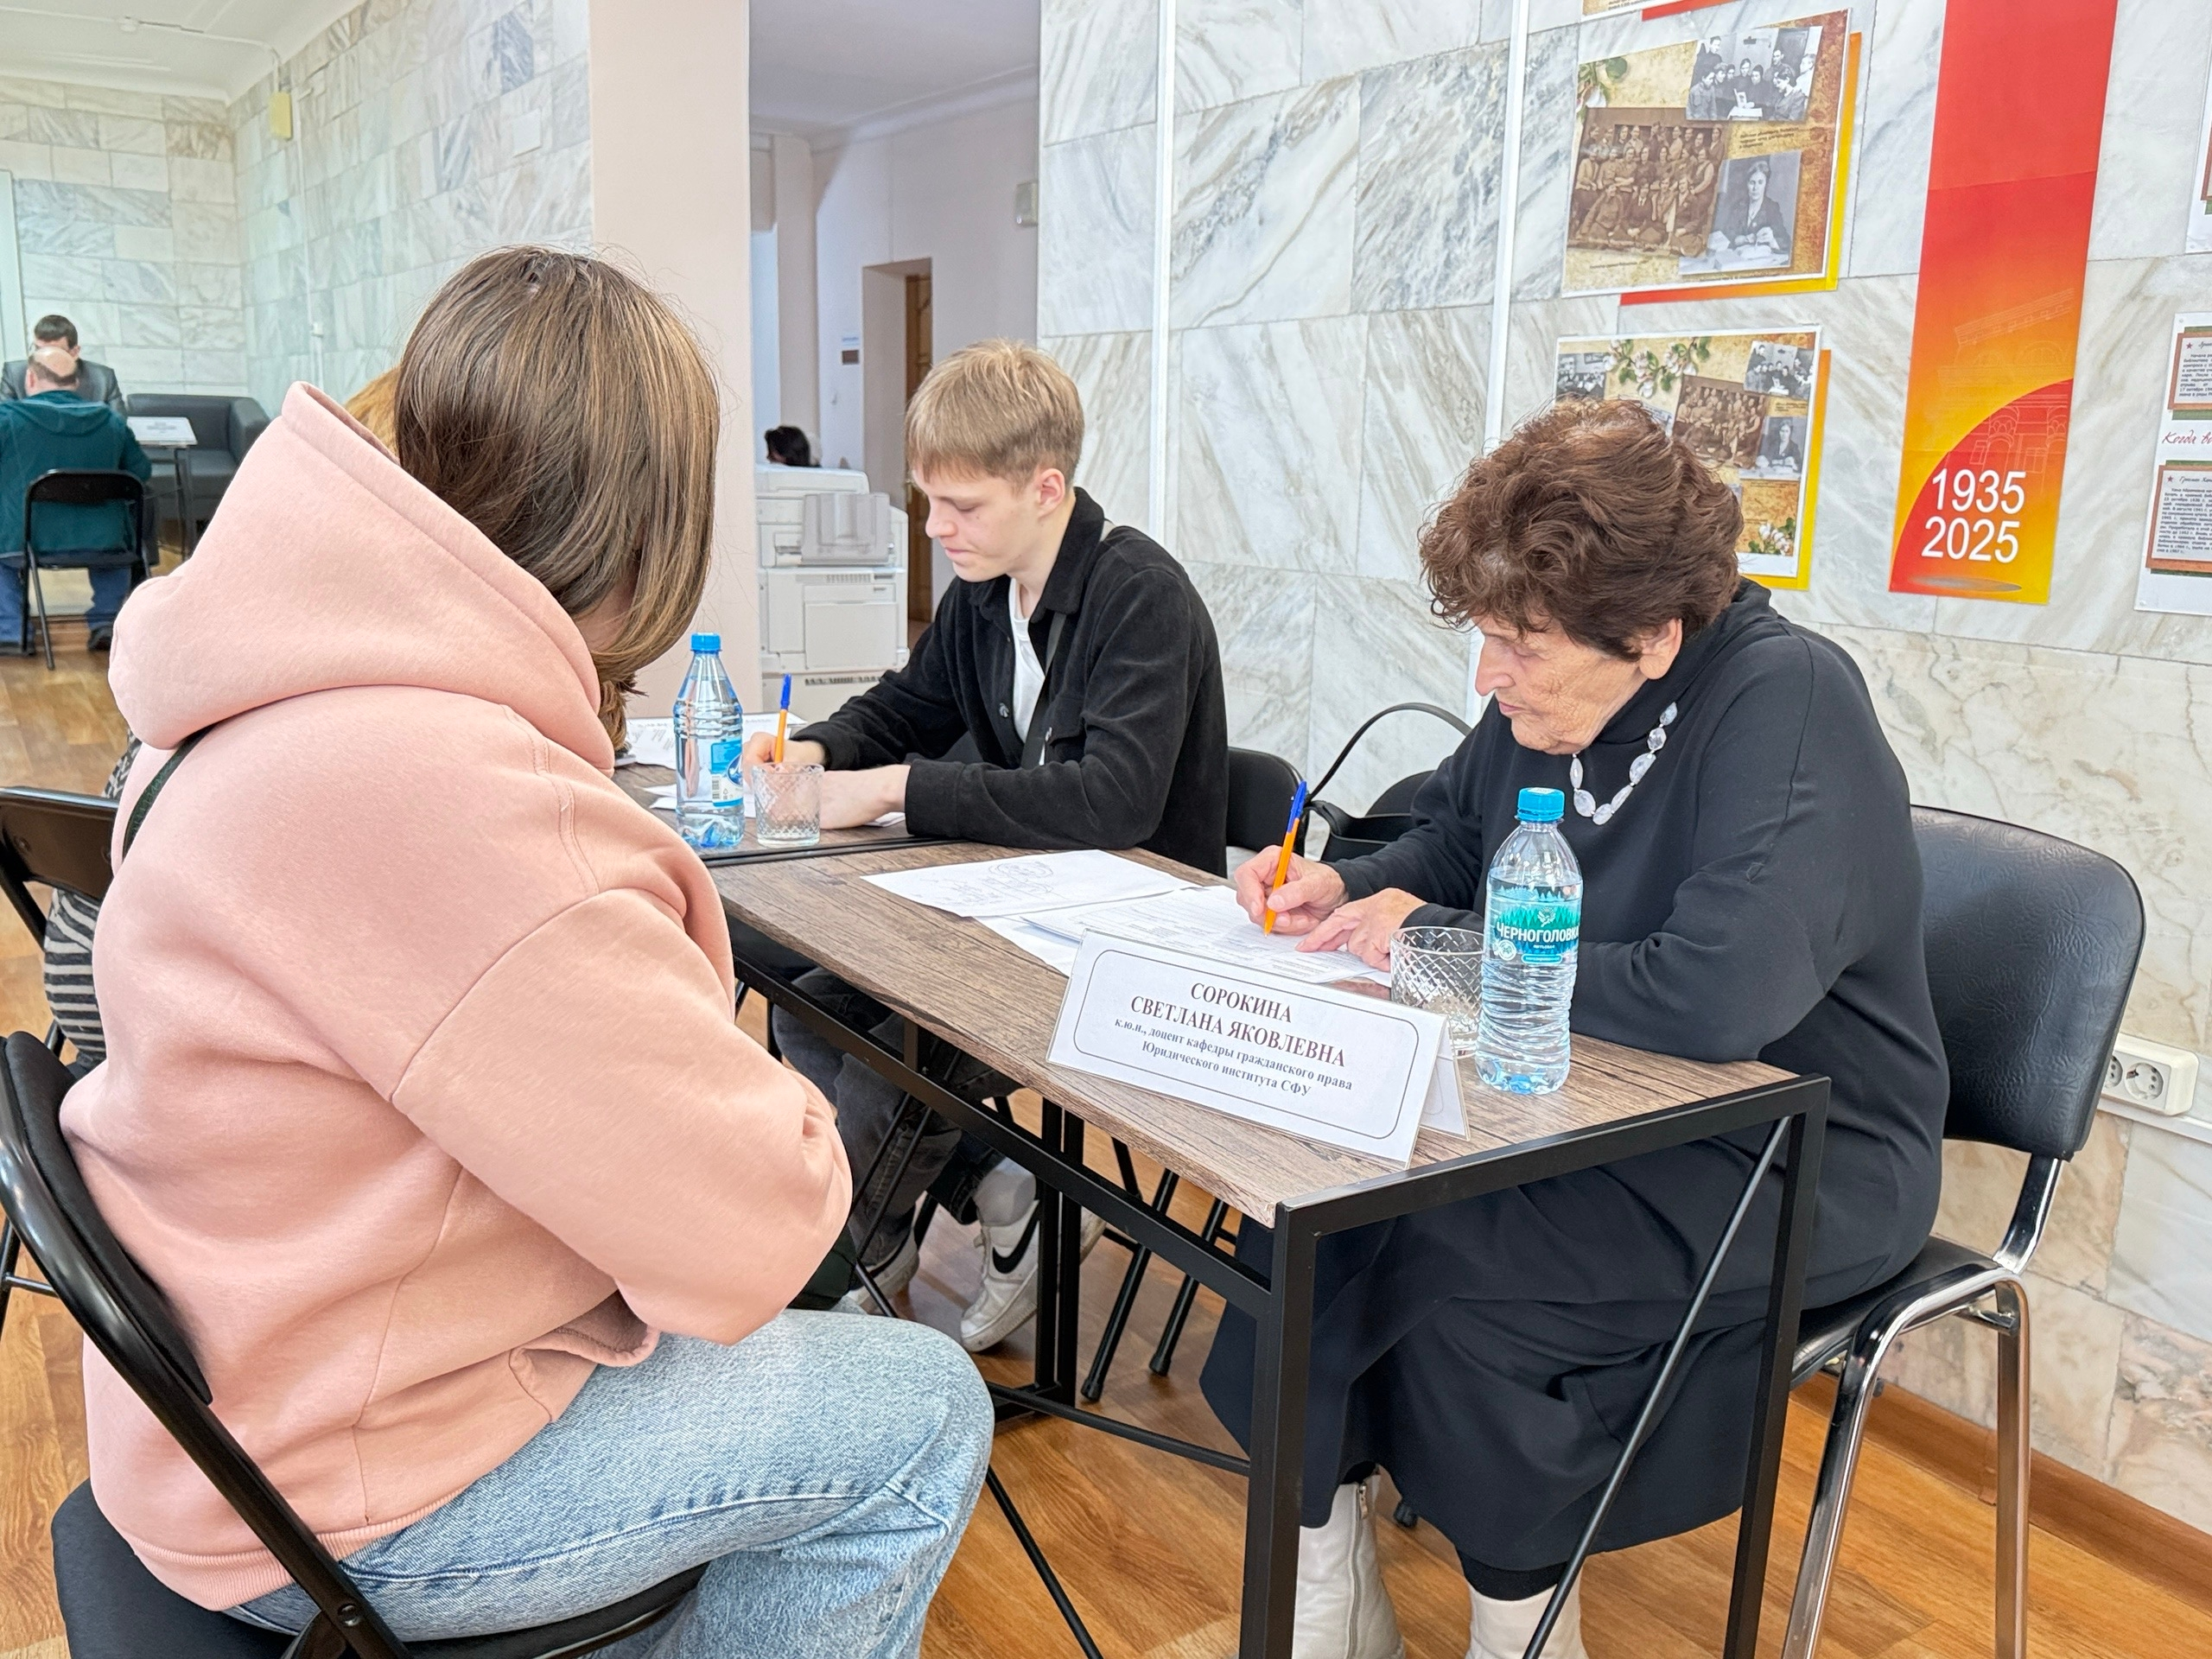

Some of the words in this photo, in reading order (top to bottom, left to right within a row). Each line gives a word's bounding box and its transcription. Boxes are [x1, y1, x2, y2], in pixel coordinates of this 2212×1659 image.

[2162, 429, 2196, 444] Когда
[1932, 467, 2026, 515] 1935
[1921, 516, 2020, 563] 2025
[1191, 982, 1292, 1023] СОРОКИНА
[1131, 995, 1223, 1034] СВЕТЛАНА
[1227, 1020, 1344, 1067] ЯКОВЛЕВНА
[1142, 1040, 1219, 1071] Юридического
[1222, 1065, 1277, 1087] института
[1281, 1079, 1312, 1096] СФУ
[1148, 1027, 1185, 1044] доцент
[1186, 1037, 1235, 1058] кафедры
[1236, 1052, 1314, 1080] гражданского
[1317, 1073, 1352, 1090] права
